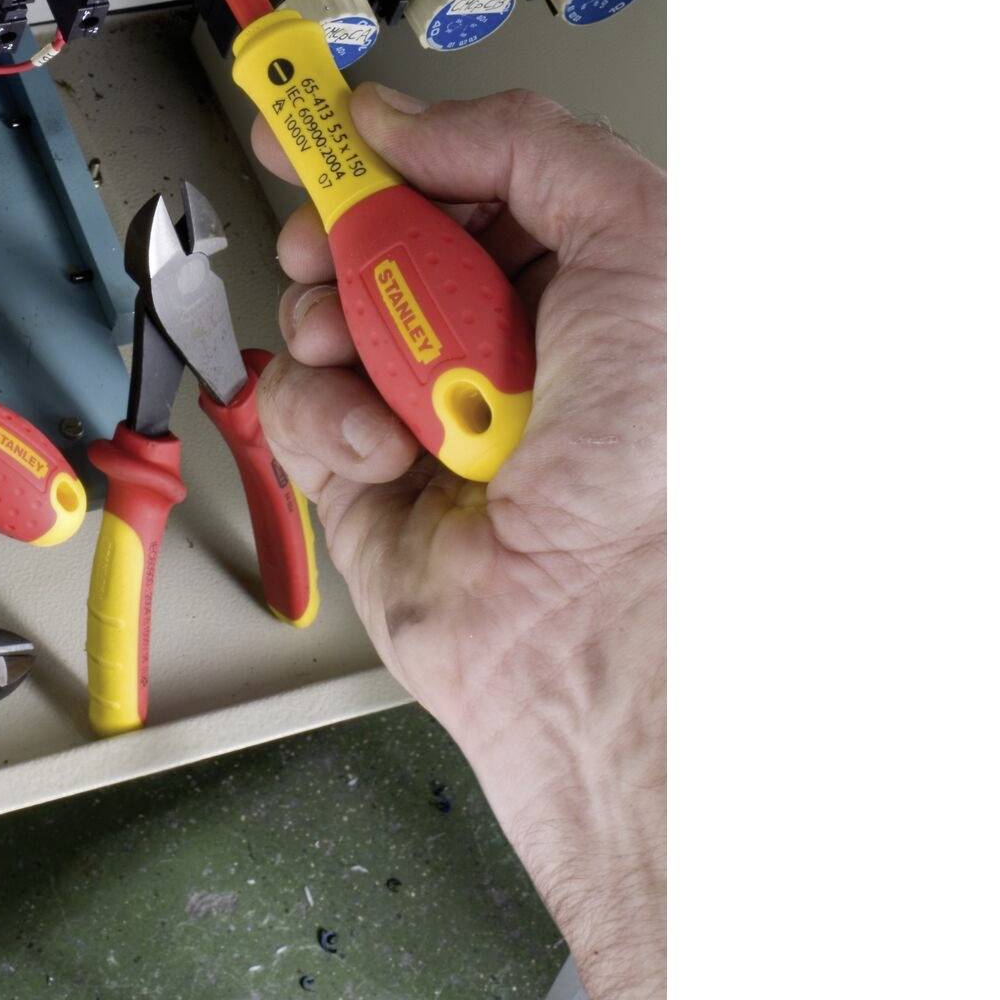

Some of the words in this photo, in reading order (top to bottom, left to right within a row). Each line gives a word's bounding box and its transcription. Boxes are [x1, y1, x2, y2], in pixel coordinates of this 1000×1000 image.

[285, 85, 305, 108] IEC
[301, 77, 335, 121] 65-413
[327, 123, 348, 144] 5.5
[339, 143, 350, 154] x
[345, 153, 368, 177] 150
[283, 113, 312, 153] 1000V
[318, 173, 333, 189] 07
[378, 268, 434, 353] STANLEY
